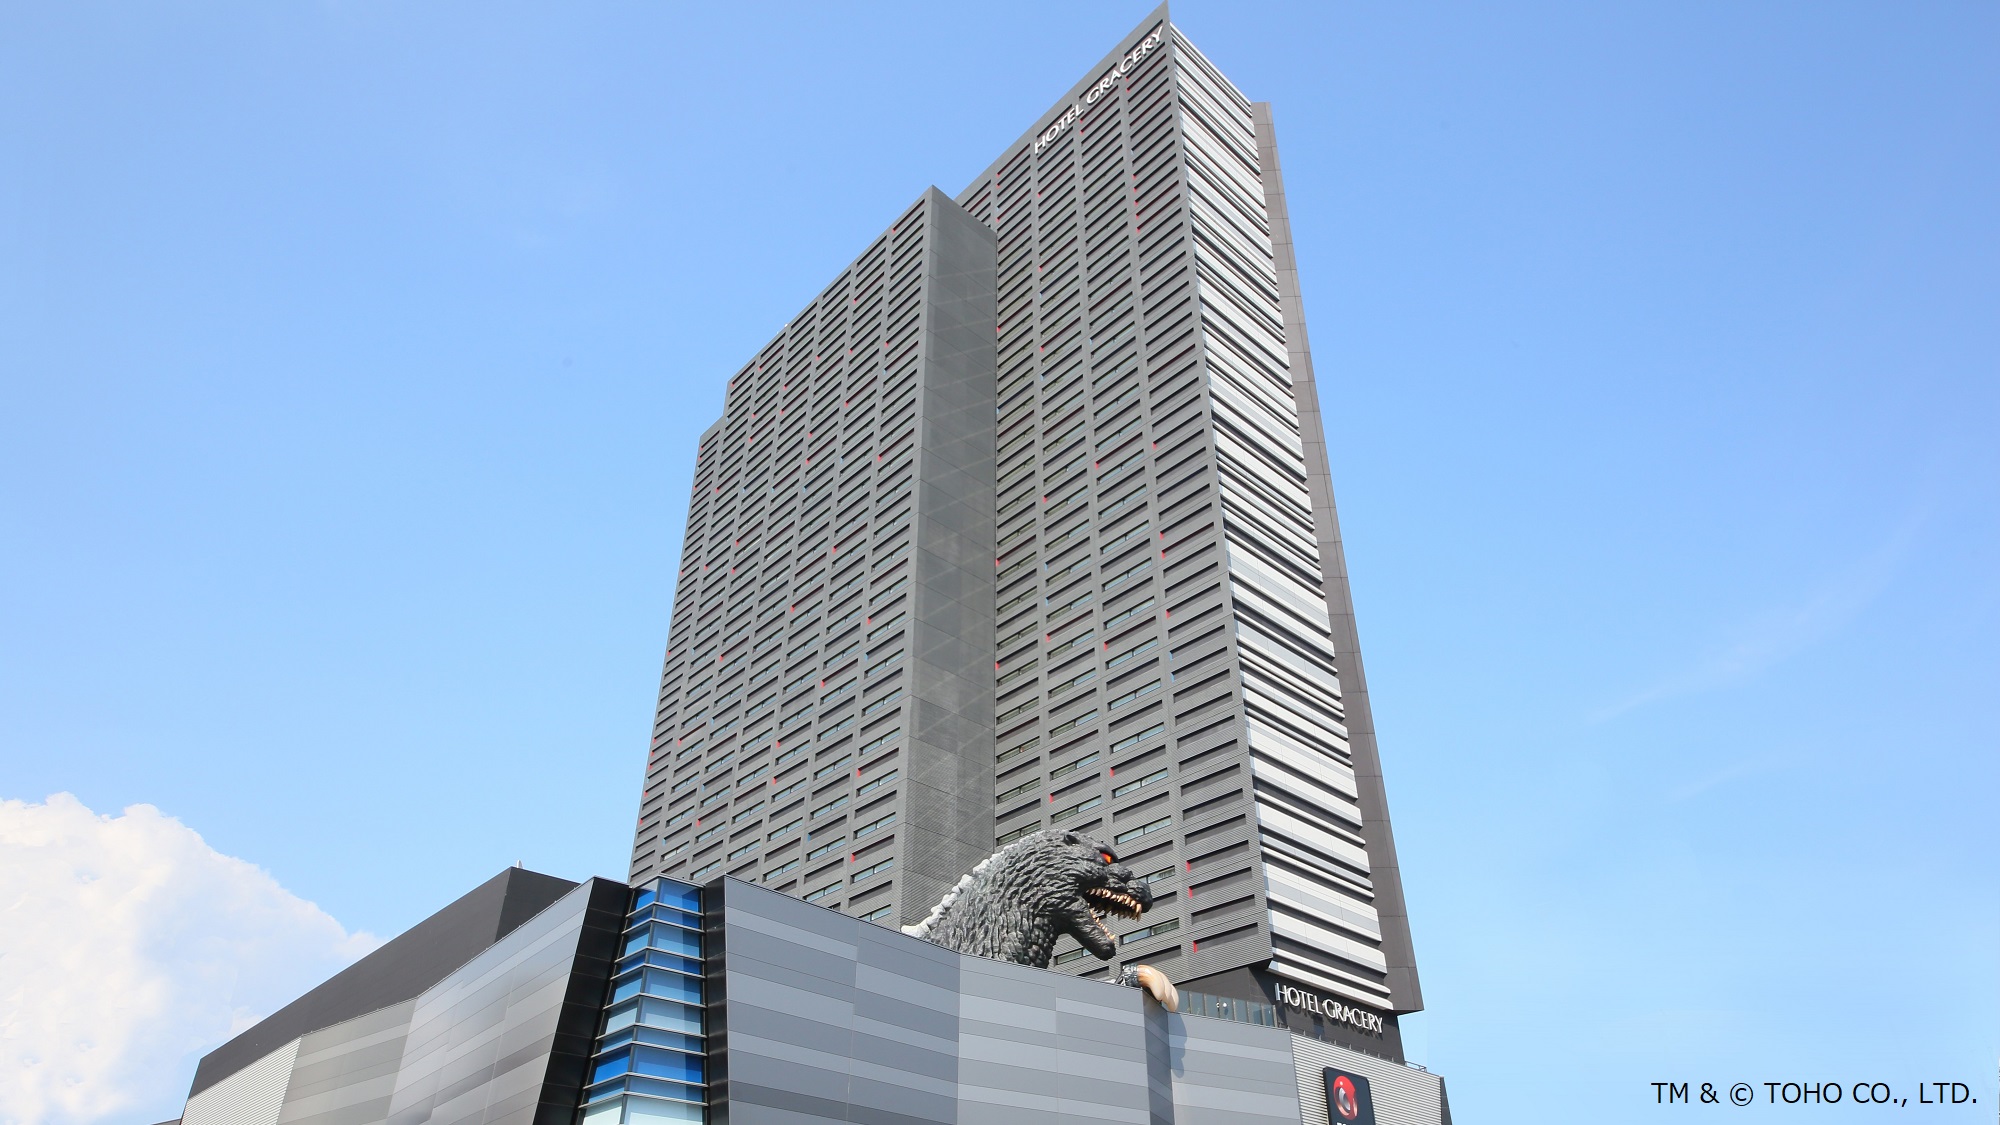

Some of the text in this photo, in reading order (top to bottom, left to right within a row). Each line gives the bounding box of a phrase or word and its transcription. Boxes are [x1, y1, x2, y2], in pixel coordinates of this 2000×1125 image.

[1034, 26, 1163, 154] HOTEL GRACERY
[1275, 982, 1383, 1034] HOTEL GRACERY
